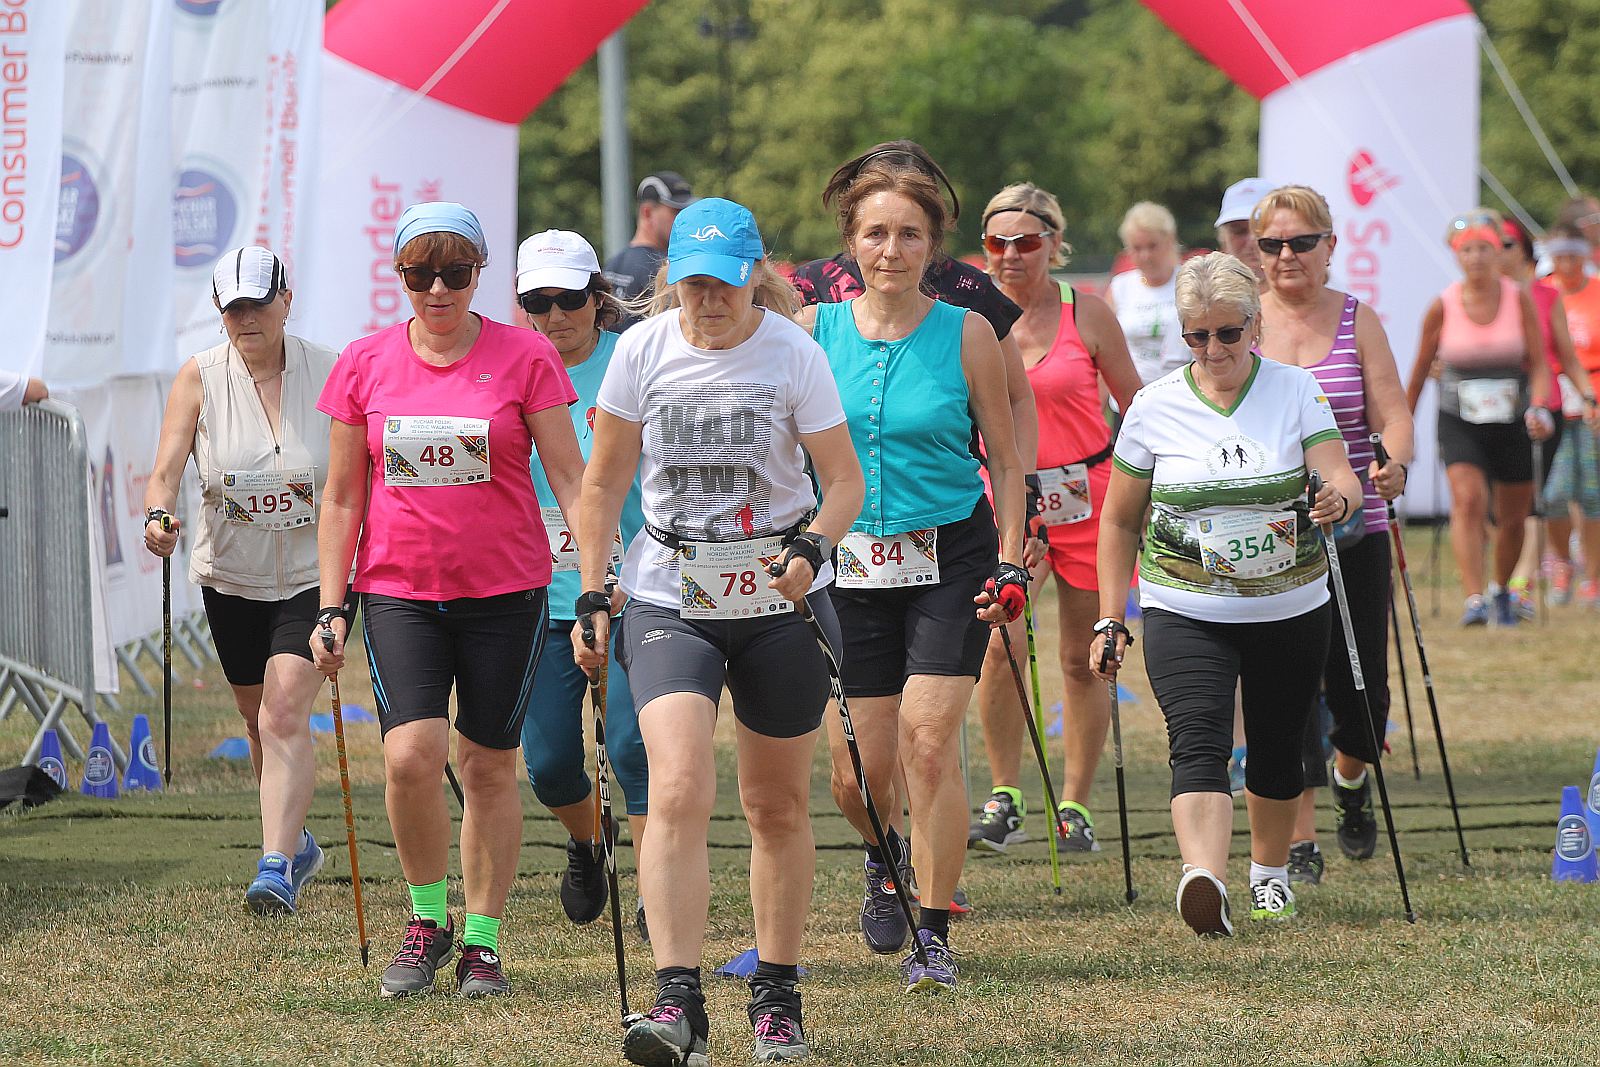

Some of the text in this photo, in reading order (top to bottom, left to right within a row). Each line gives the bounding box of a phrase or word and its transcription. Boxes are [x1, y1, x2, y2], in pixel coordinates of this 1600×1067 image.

[0, 46, 27, 249] Consumer
[363, 175, 401, 333] tander
[1347, 219, 1391, 322] San
[419, 445, 455, 467] 48
[247, 491, 294, 514] 195
[560, 531, 579, 553] 2
[733, 543, 752, 551] POLSKI
[764, 540, 782, 549] LEGNIC
[870, 541, 905, 567] 84
[1228, 533, 1276, 562] 354
[720, 570, 757, 597] 78
